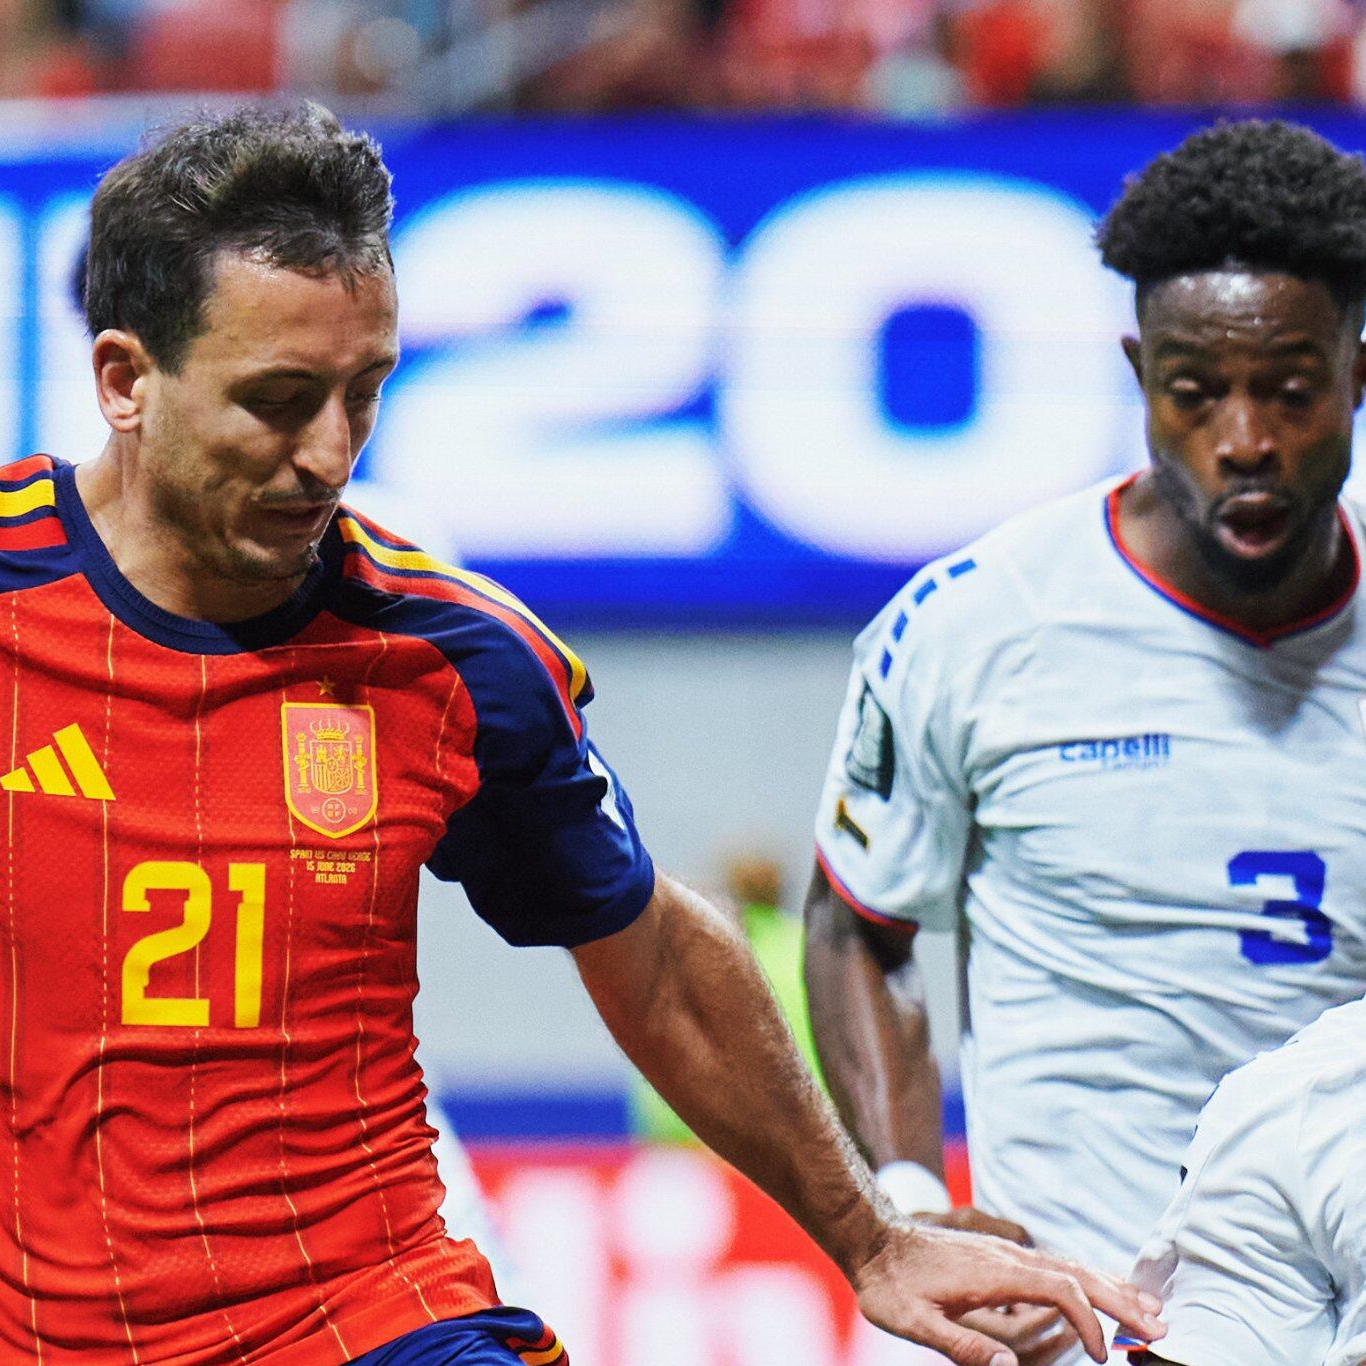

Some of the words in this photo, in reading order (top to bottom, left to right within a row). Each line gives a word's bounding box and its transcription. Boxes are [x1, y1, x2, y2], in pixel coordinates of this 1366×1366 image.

[315, 872, 347, 884] ATLANTA
[1226, 849, 1334, 965] 3
[120, 860, 266, 1028] 21
